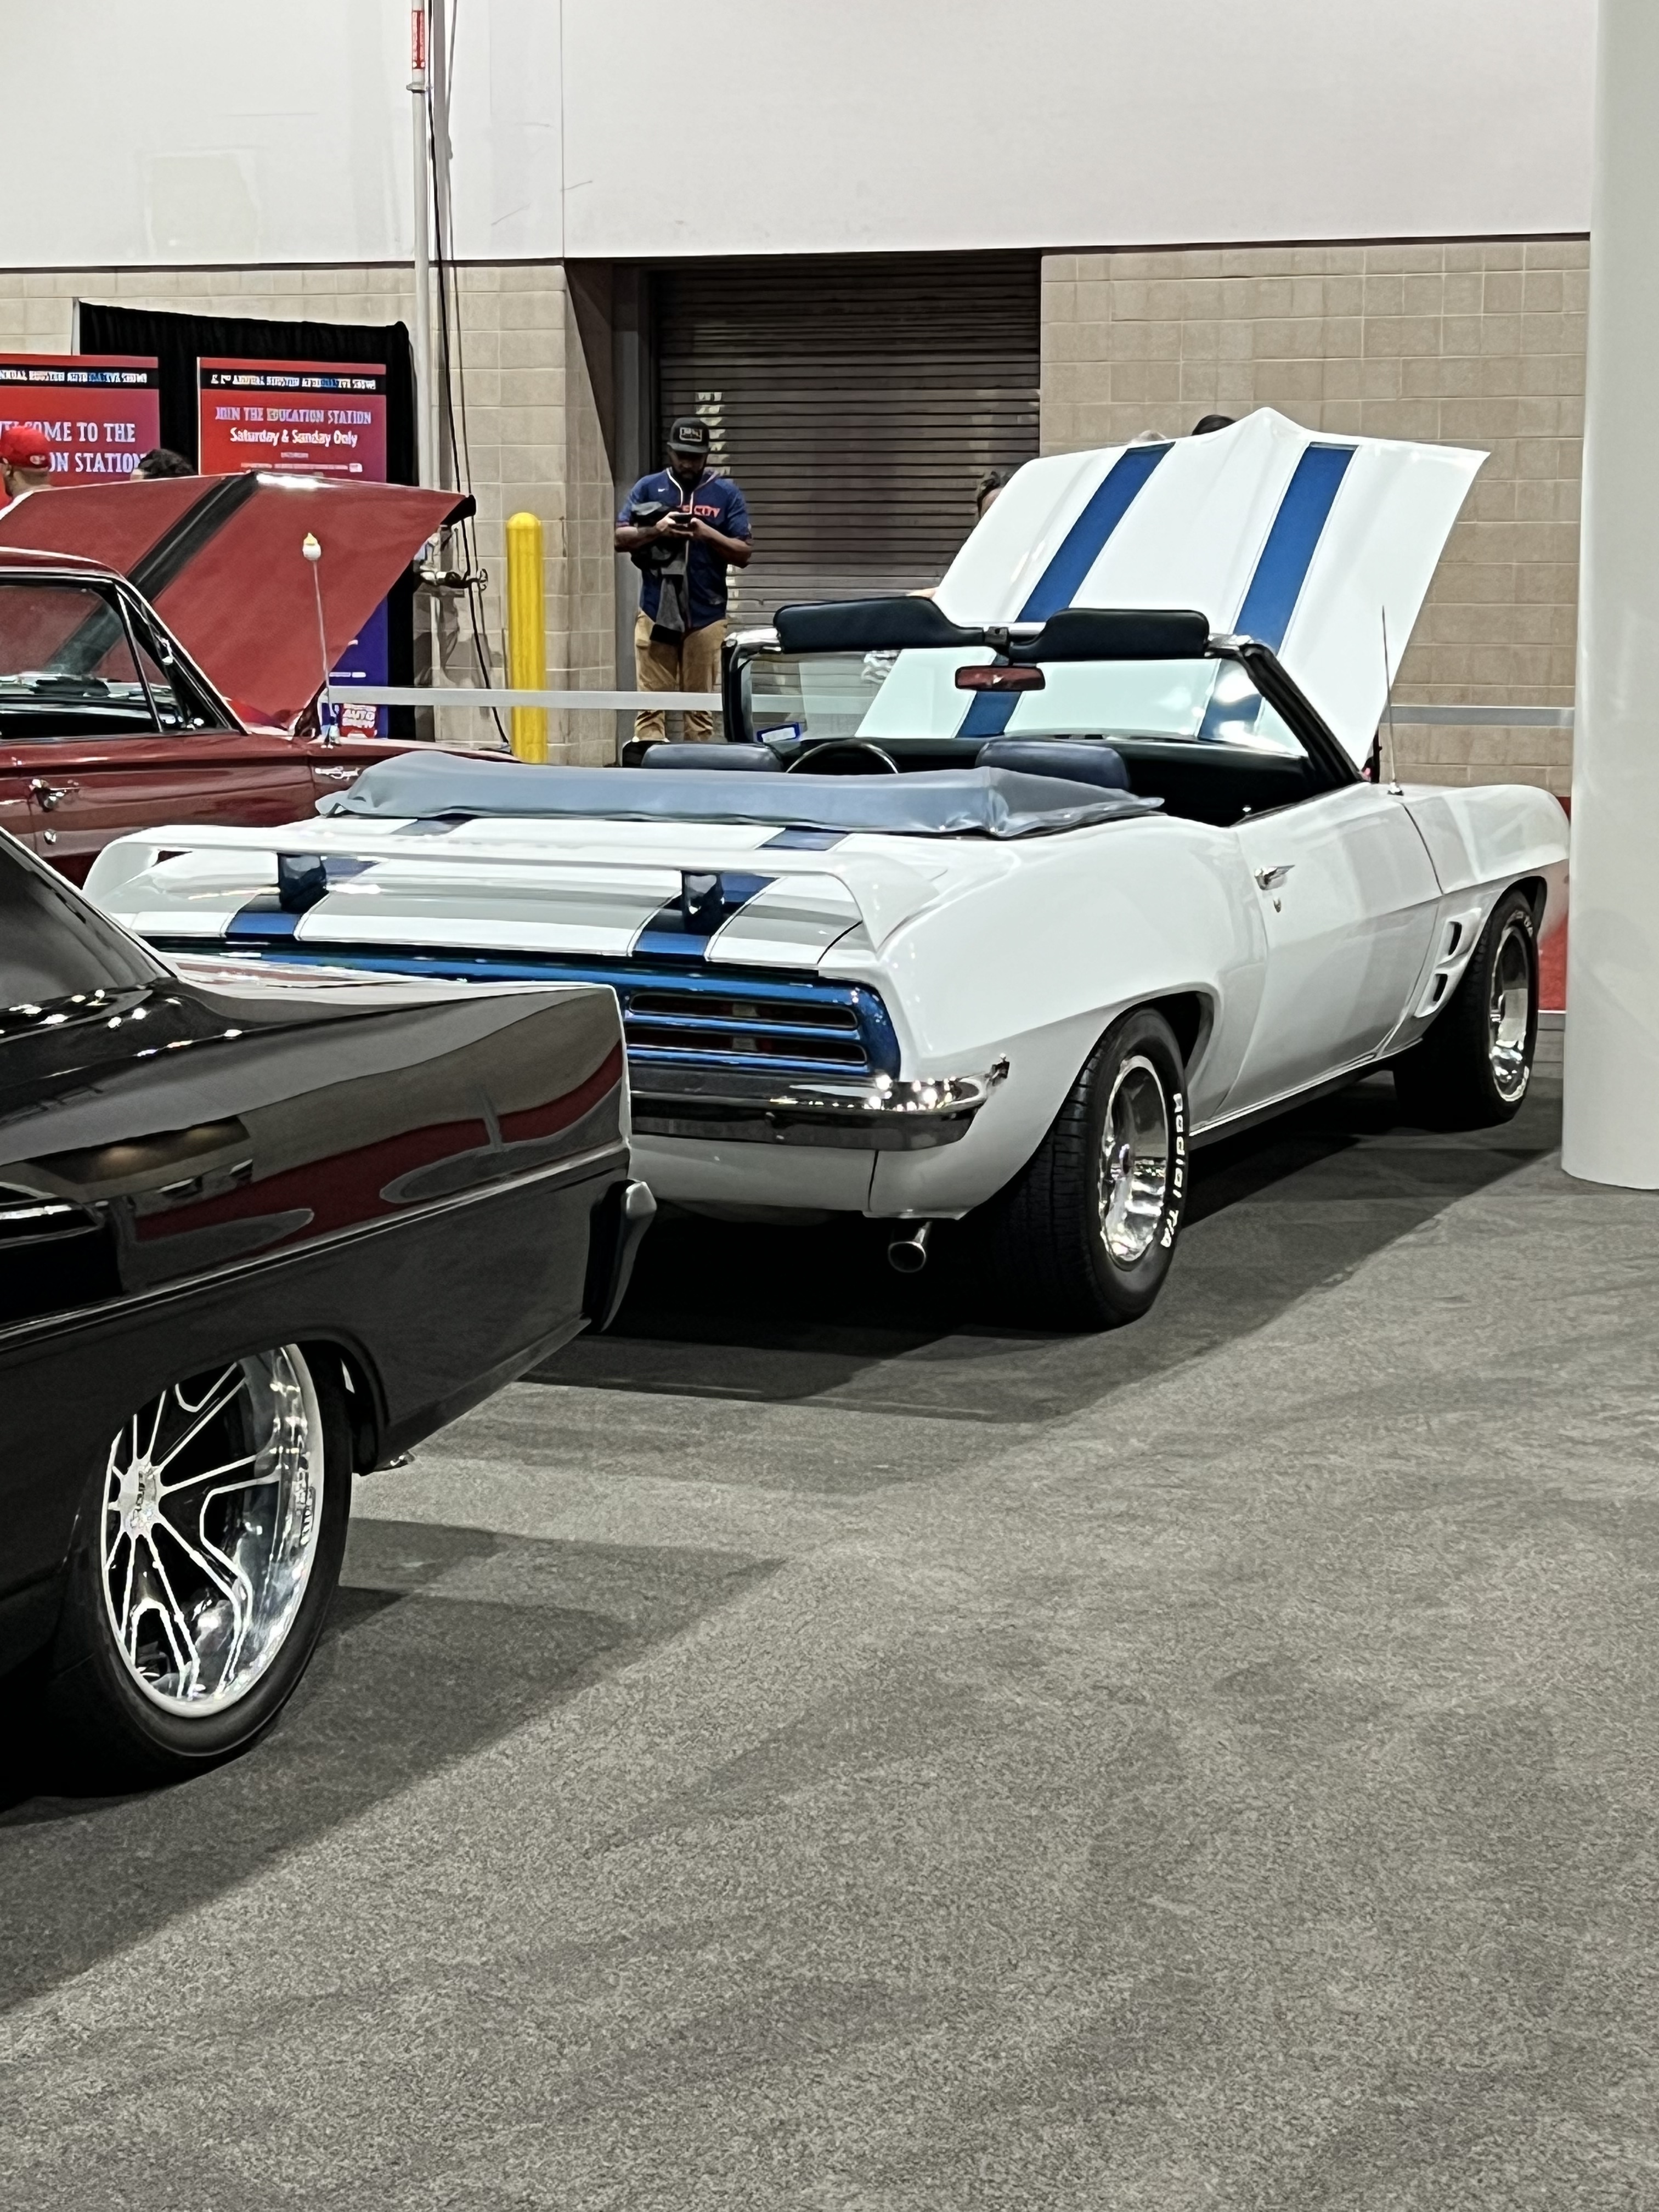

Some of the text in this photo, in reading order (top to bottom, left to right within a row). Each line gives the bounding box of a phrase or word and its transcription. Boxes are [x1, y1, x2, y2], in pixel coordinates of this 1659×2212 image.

[215, 407, 371, 424] JOIN THE EDUCATION STATION
[76, 421, 98, 442] TO
[103, 422, 136, 443] THE
[230, 427, 358, 448] Saturday & Sunday Only
[693, 505, 720, 518] CITY
